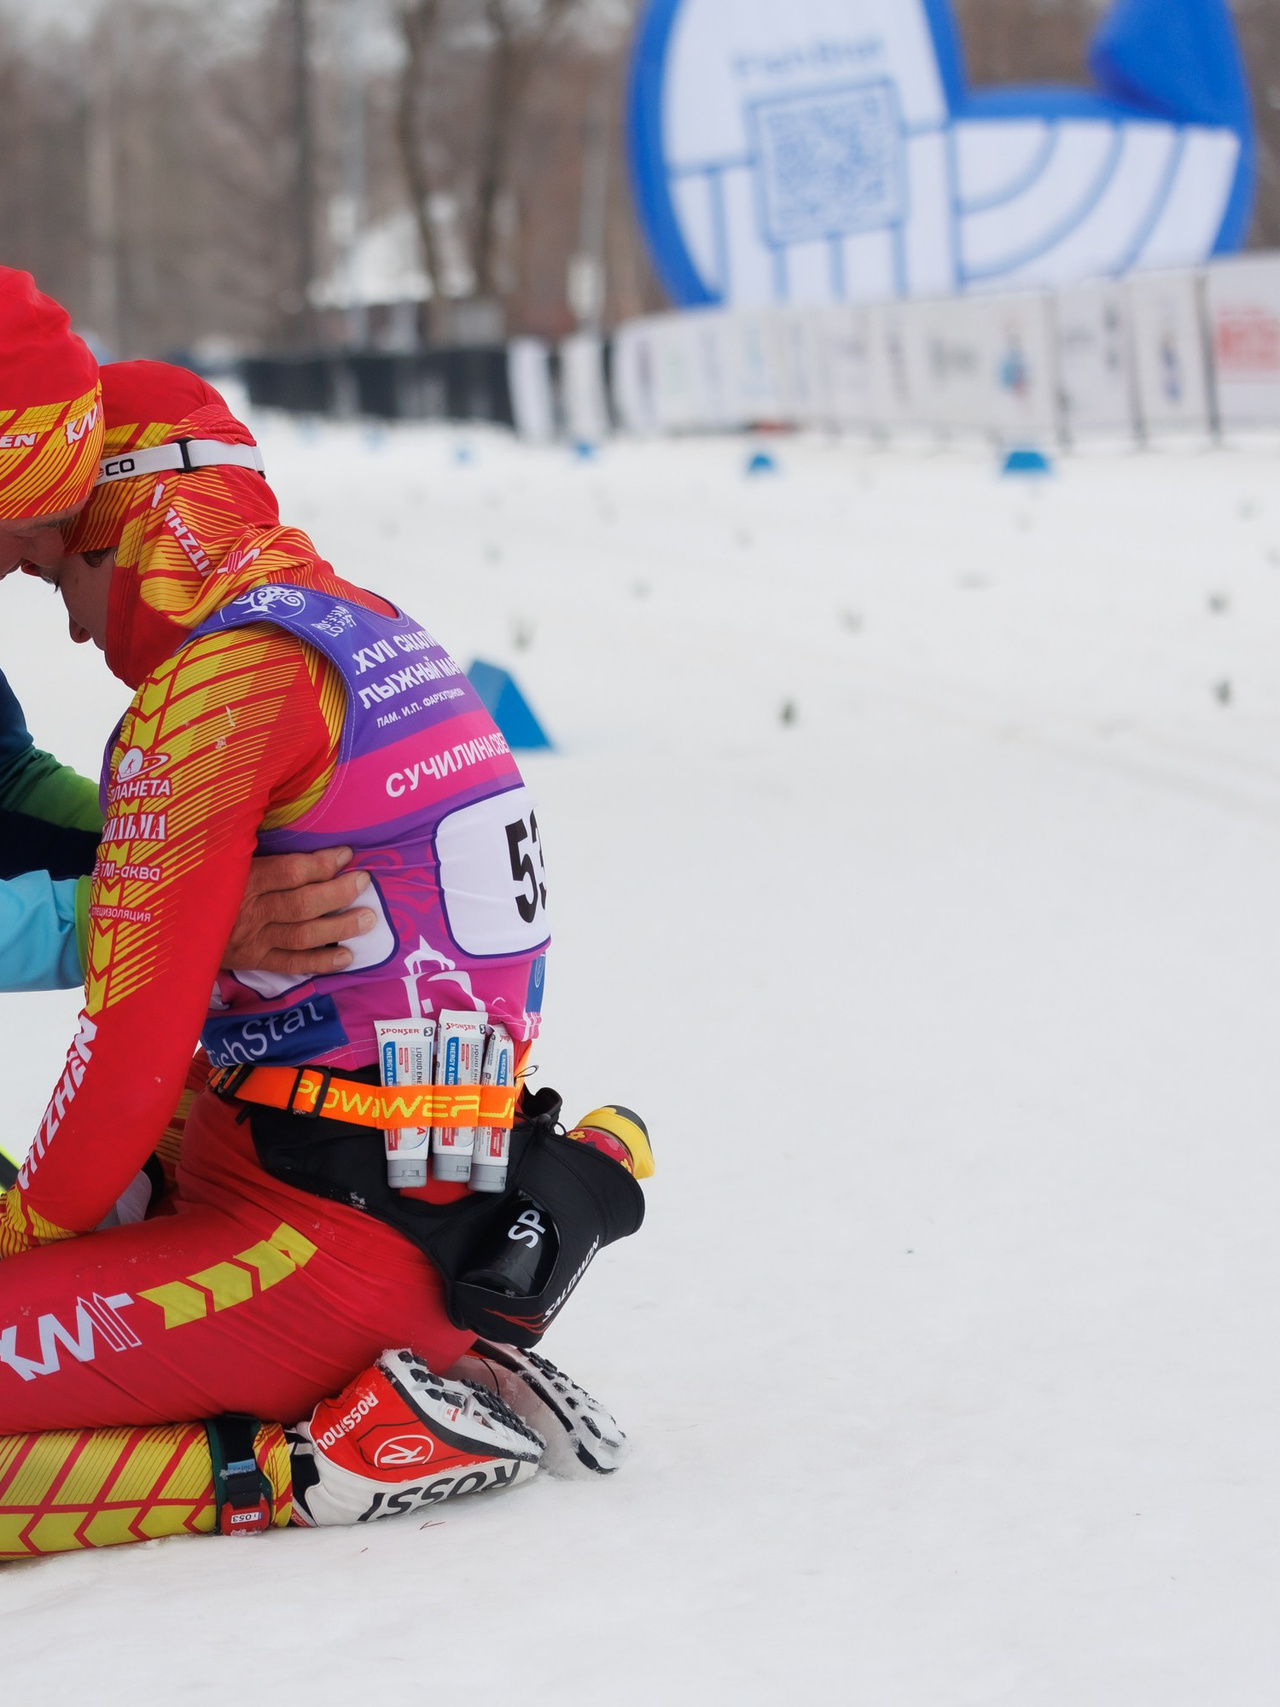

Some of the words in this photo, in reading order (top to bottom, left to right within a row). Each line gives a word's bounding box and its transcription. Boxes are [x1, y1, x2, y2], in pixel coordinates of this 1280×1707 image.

[358, 655, 444, 709] ЛЫЖНЫЙ
[376, 711, 402, 728] ПАМ.
[401, 702, 423, 717] И.П.
[110, 779, 171, 803] ПЛАНЕТА
[91, 907, 151, 923] СПЕЦИЗОЛЯЦИЯ
[380, 1027, 421, 1036] SPONSER
[445, 1022, 477, 1031] SPONSER
[385, 1047, 393, 1071] ENERGY
[415, 1047, 423, 1070] LIQUID
[449, 1042, 457, 1066] ENERGY
[542, 1234, 600, 1323] SALOMON
[232, 1513, 252, 1523] 053
